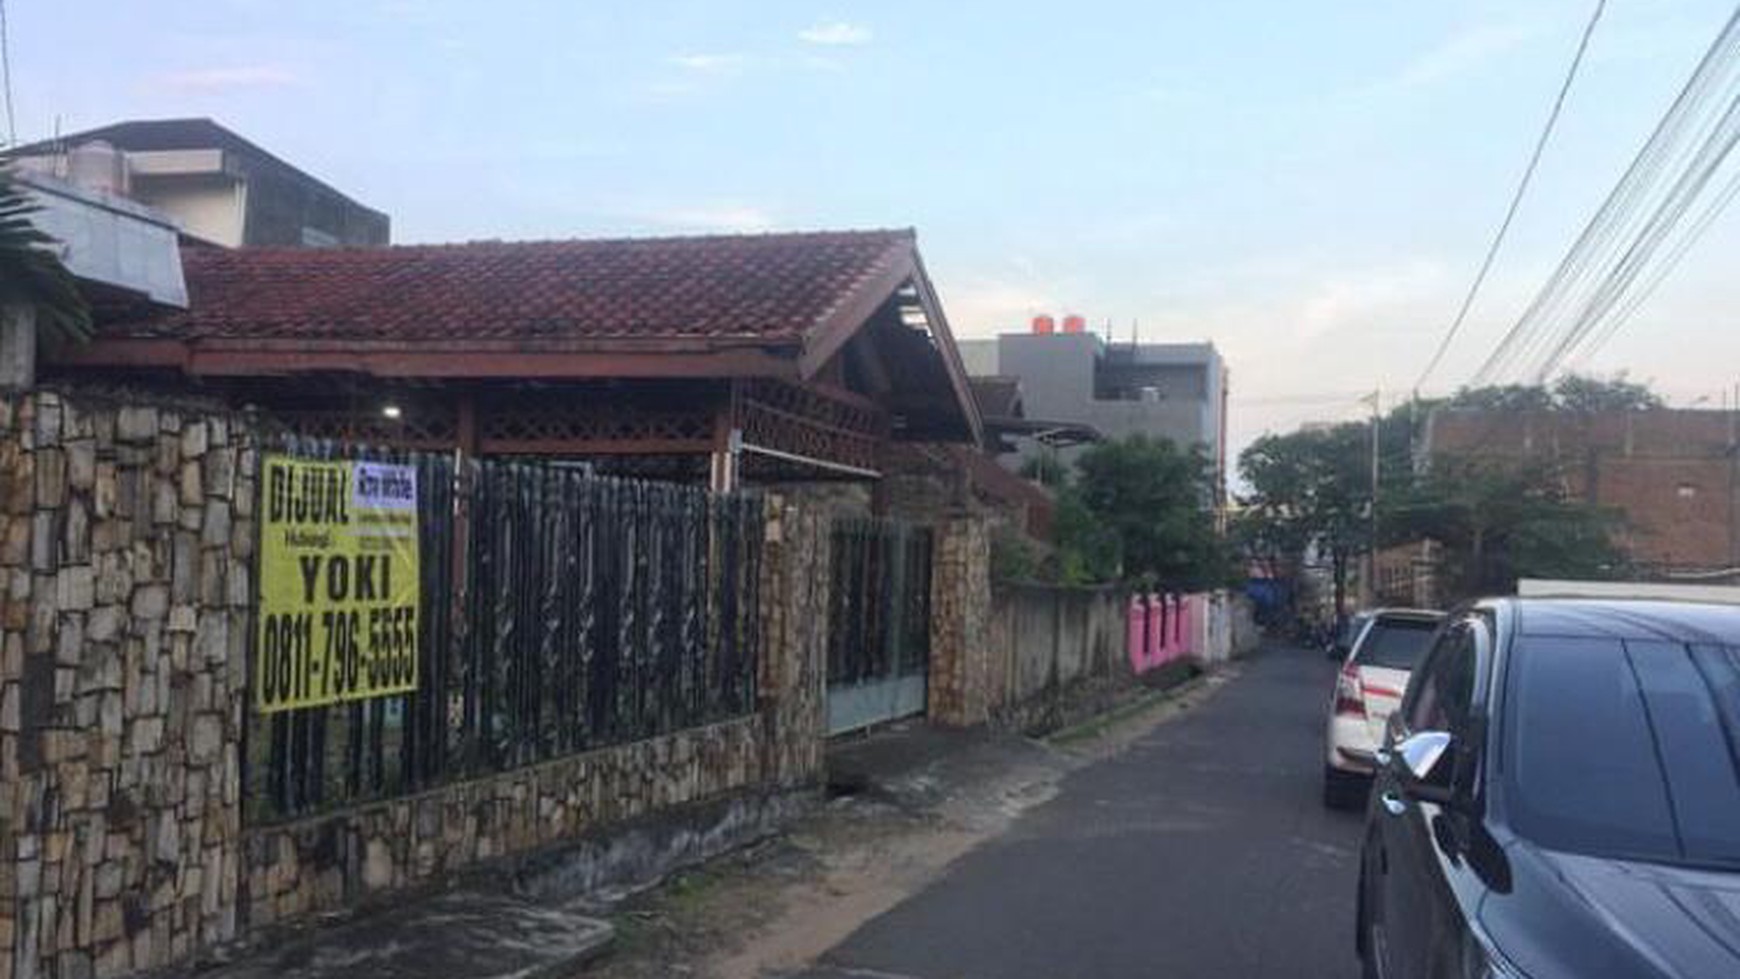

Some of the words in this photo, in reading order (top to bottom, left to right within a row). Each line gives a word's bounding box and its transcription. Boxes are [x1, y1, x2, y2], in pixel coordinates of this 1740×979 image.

[270, 464, 348, 524] DIJUAL
[300, 555, 390, 603] YOKI
[263, 607, 414, 704] 0811-796-5555
